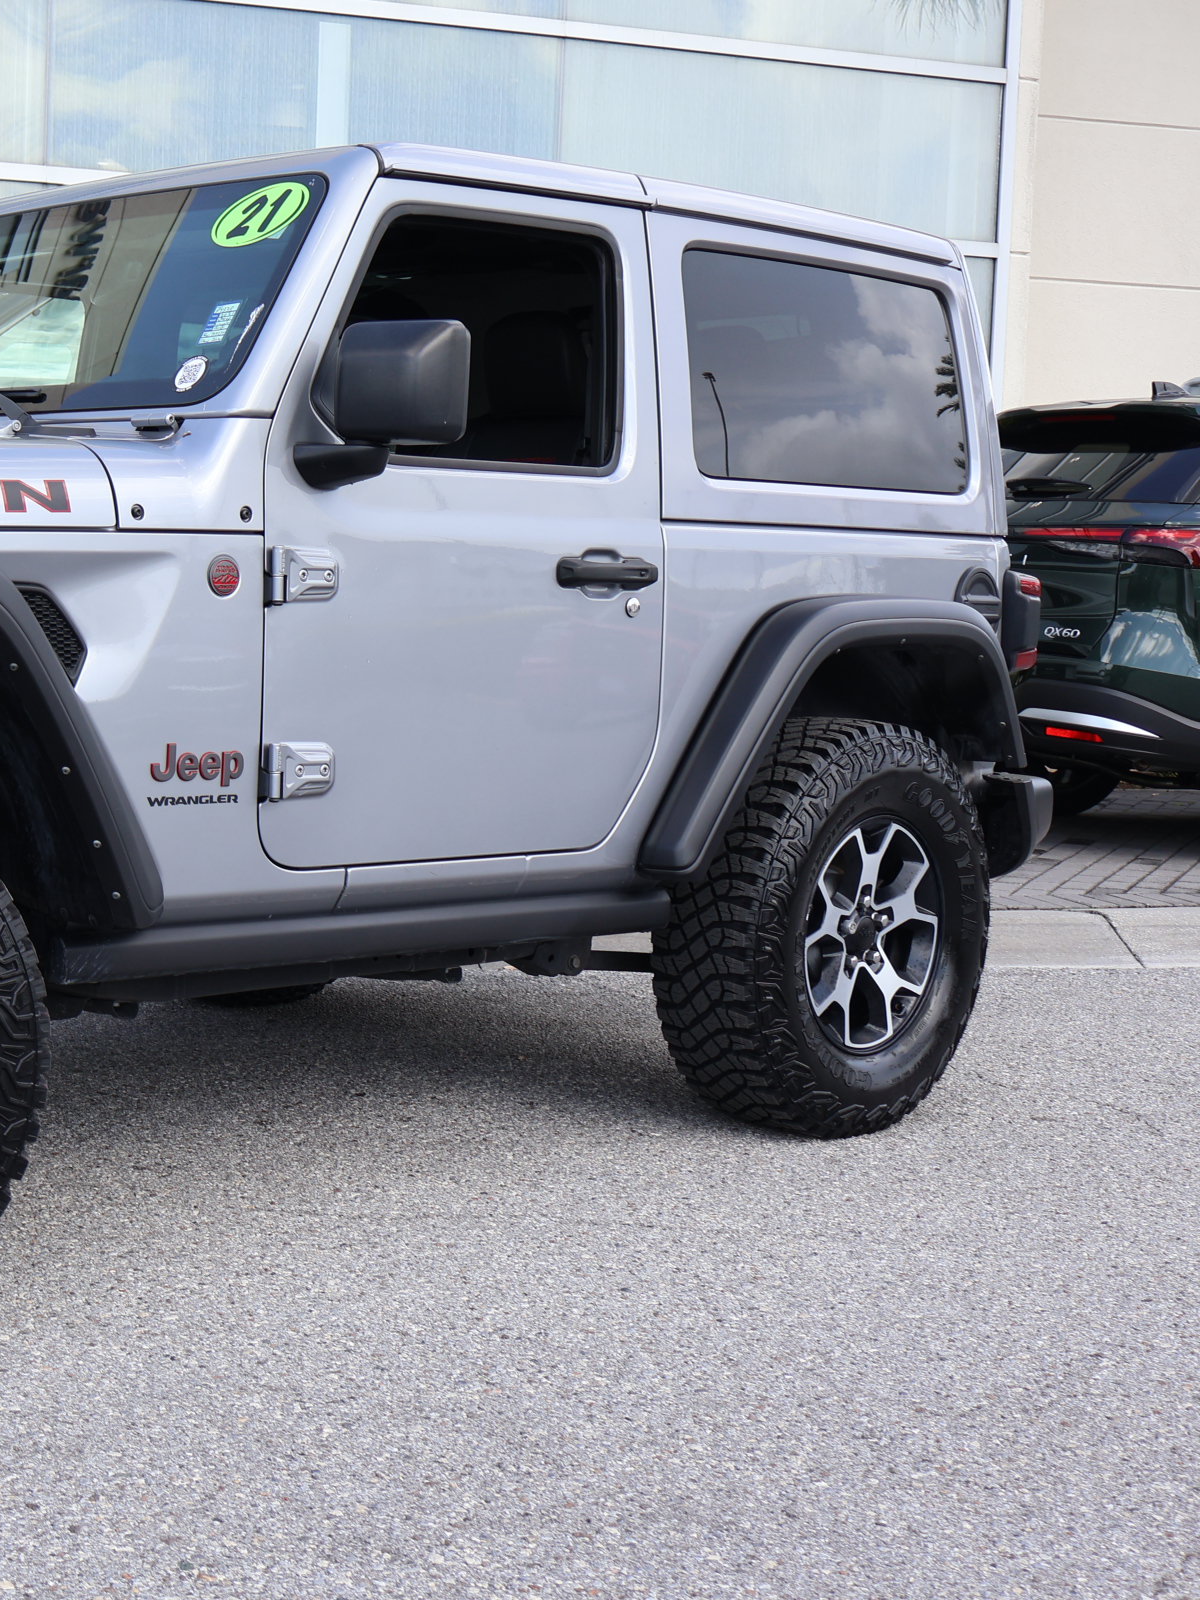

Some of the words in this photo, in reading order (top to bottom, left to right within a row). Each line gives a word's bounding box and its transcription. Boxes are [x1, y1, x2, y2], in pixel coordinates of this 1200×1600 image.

[226, 189, 293, 240] 21
[1044, 626, 1080, 638] QX60
[150, 743, 244, 787] Jeep
[147, 794, 239, 807] WRANGLER
